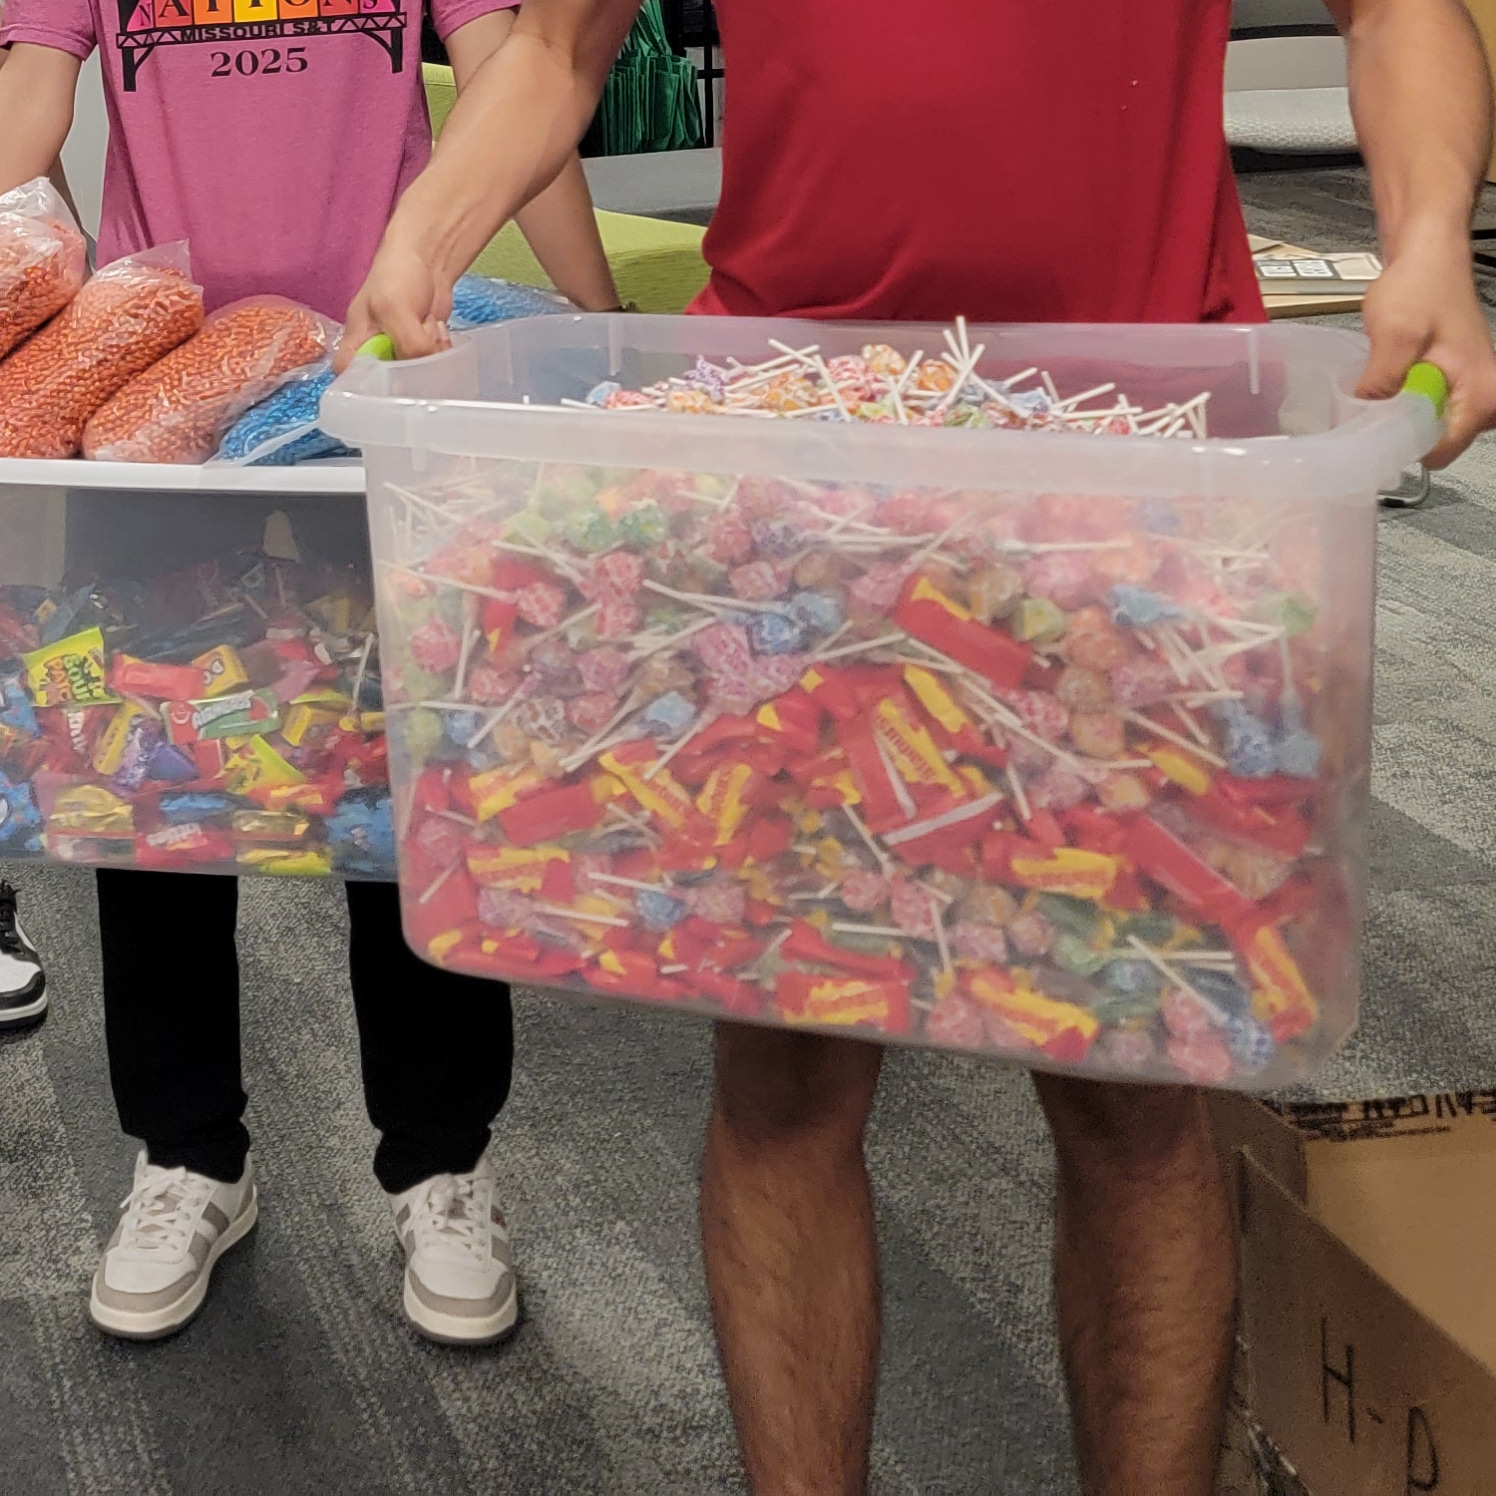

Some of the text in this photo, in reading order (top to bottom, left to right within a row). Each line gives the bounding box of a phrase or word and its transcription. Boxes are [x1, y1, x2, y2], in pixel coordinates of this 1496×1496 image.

[181, 20, 334, 41] MISSOURI S&T
[210, 47, 309, 78] 2025
